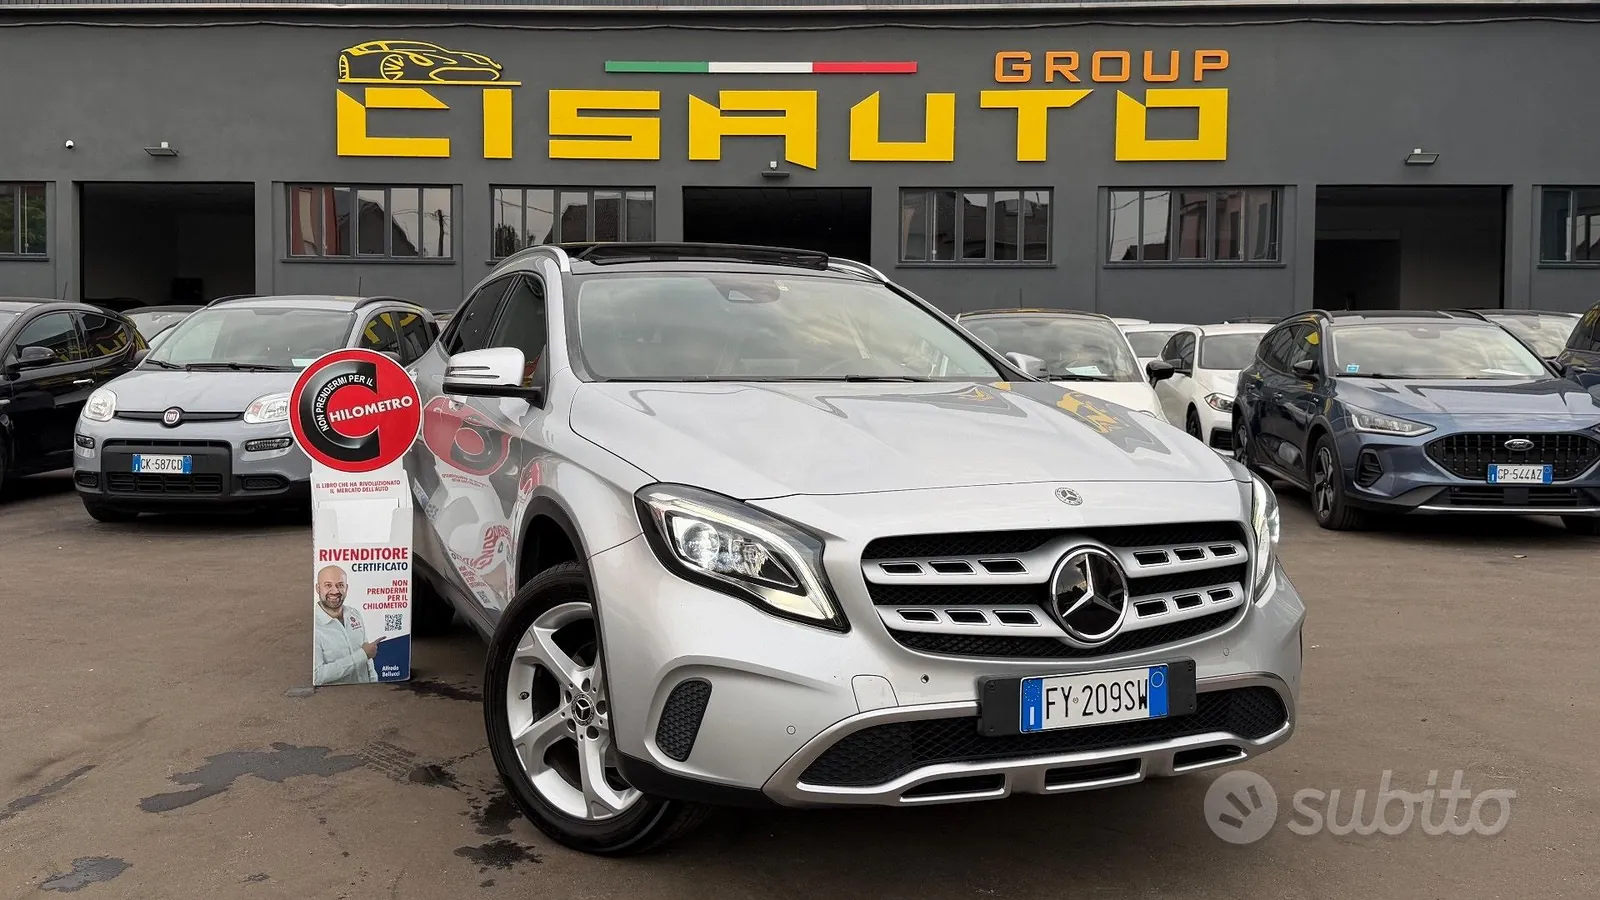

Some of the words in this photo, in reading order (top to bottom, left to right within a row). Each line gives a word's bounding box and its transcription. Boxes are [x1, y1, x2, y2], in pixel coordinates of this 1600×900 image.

[994, 49, 1229, 83] GROUP
[337, 87, 1228, 169] CISAUTO
[348, 374, 365, 383] PER
[366, 378, 374, 387] IL
[316, 375, 348, 413] PRENDERMI
[317, 415, 329, 432] NON
[320, 547, 408, 562] RIVENDITORE
[351, 562, 408, 572] CERTIFICATO
[367, 587, 408, 595] PRENDERMI
[362, 601, 408, 610] CHILOMETRO
